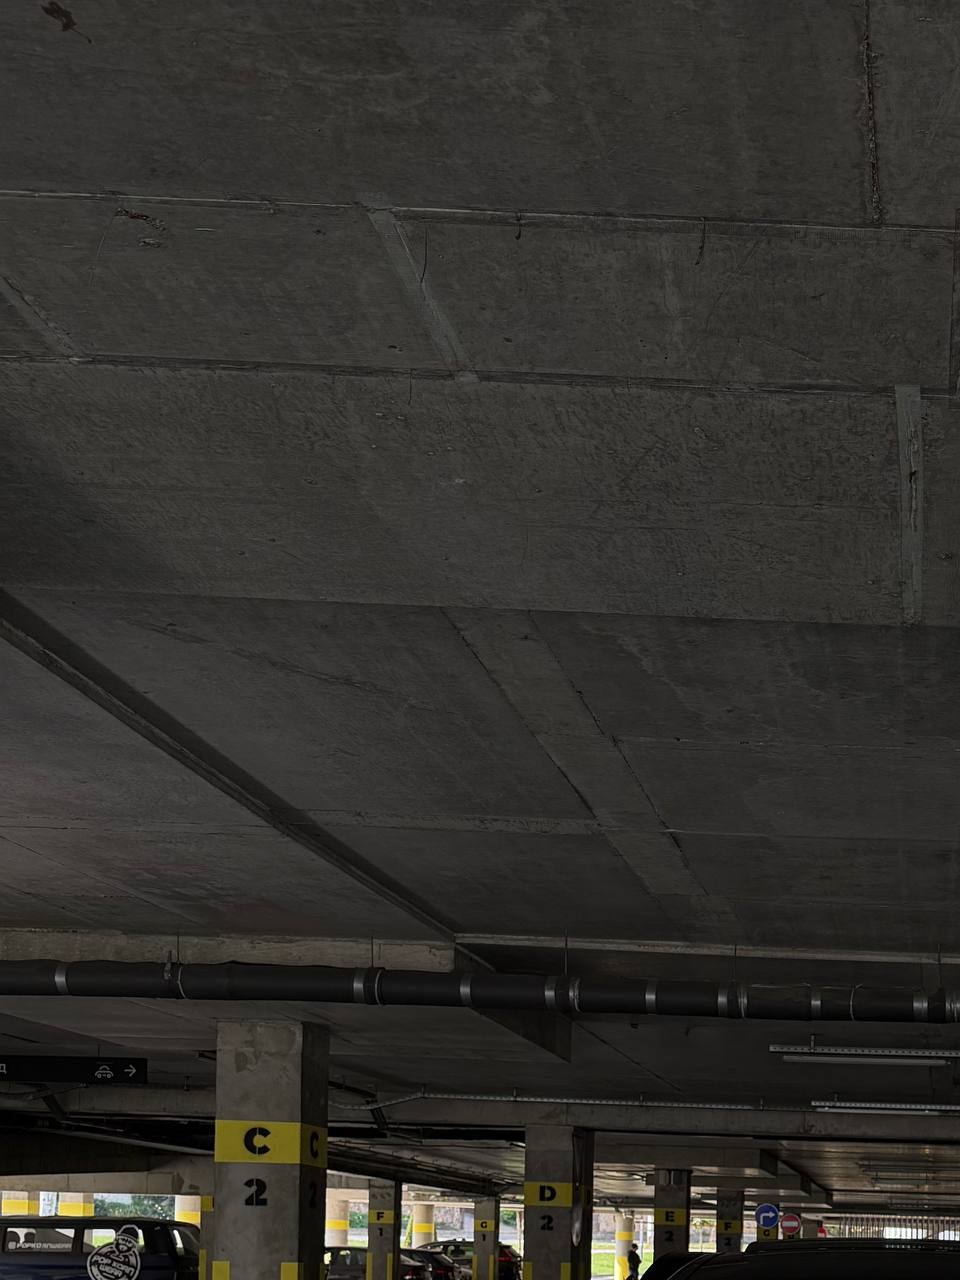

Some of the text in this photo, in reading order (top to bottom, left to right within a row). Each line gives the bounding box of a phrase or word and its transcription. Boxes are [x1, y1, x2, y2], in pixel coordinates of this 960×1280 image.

[244, 1127, 271, 1153] C
[310, 1132, 319, 1158] C
[244, 1178, 267, 1206] 2
[539, 1185, 556, 1201] D
[376, 1212, 385, 1221] F
[541, 1215, 554, 1231] 2
[665, 1211, 674, 1222] E
[725, 1223, 732, 1231] F
[665, 1231, 674, 1242] 2
